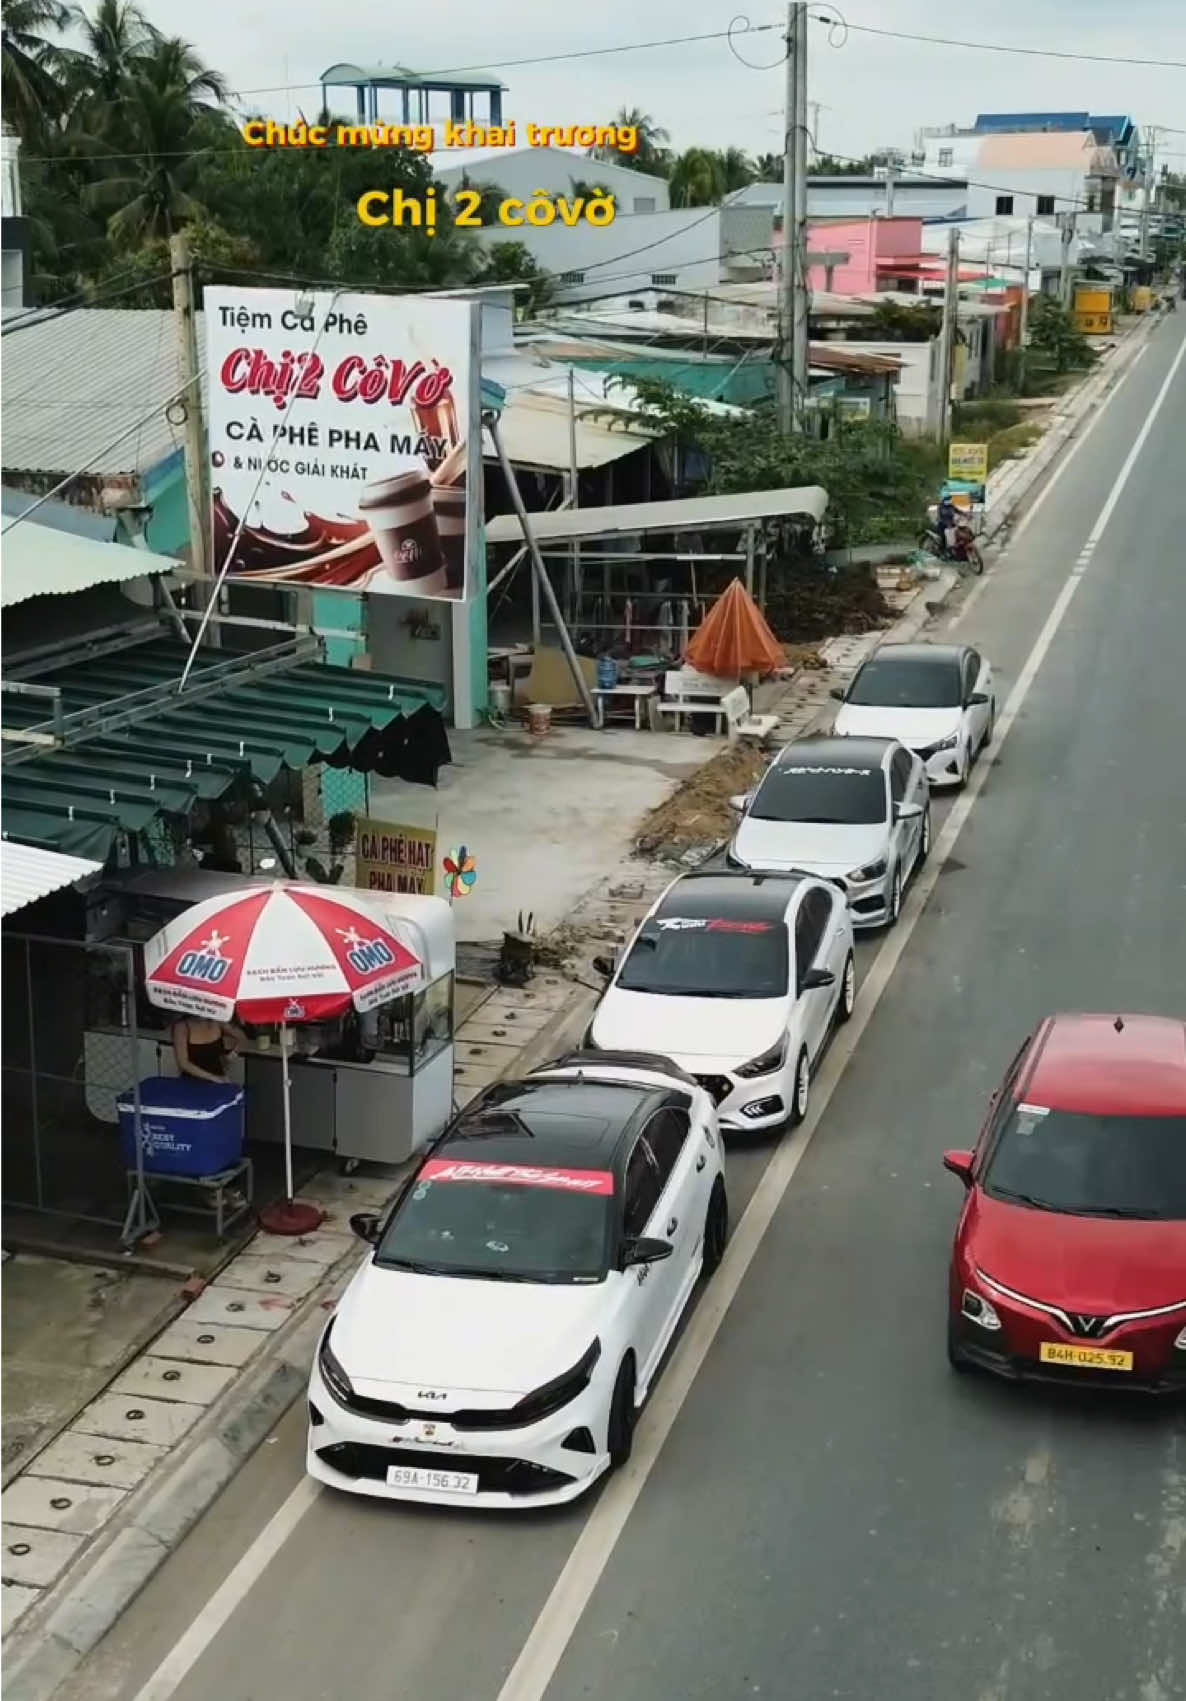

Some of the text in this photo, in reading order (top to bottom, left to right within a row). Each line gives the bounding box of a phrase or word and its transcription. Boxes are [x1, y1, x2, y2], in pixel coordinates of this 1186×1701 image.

[218, 306, 272, 334] Tiệm
[323, 312, 368, 336] Phê
[331, 354, 453, 408] CôVờ
[226, 416, 447, 459] CÀ PHÊ PHA MÁY
[233, 455, 243, 470] &
[330, 459, 368, 481] KHÁT
[178, 953, 228, 981] OMO
[349, 941, 393, 972] OMO
